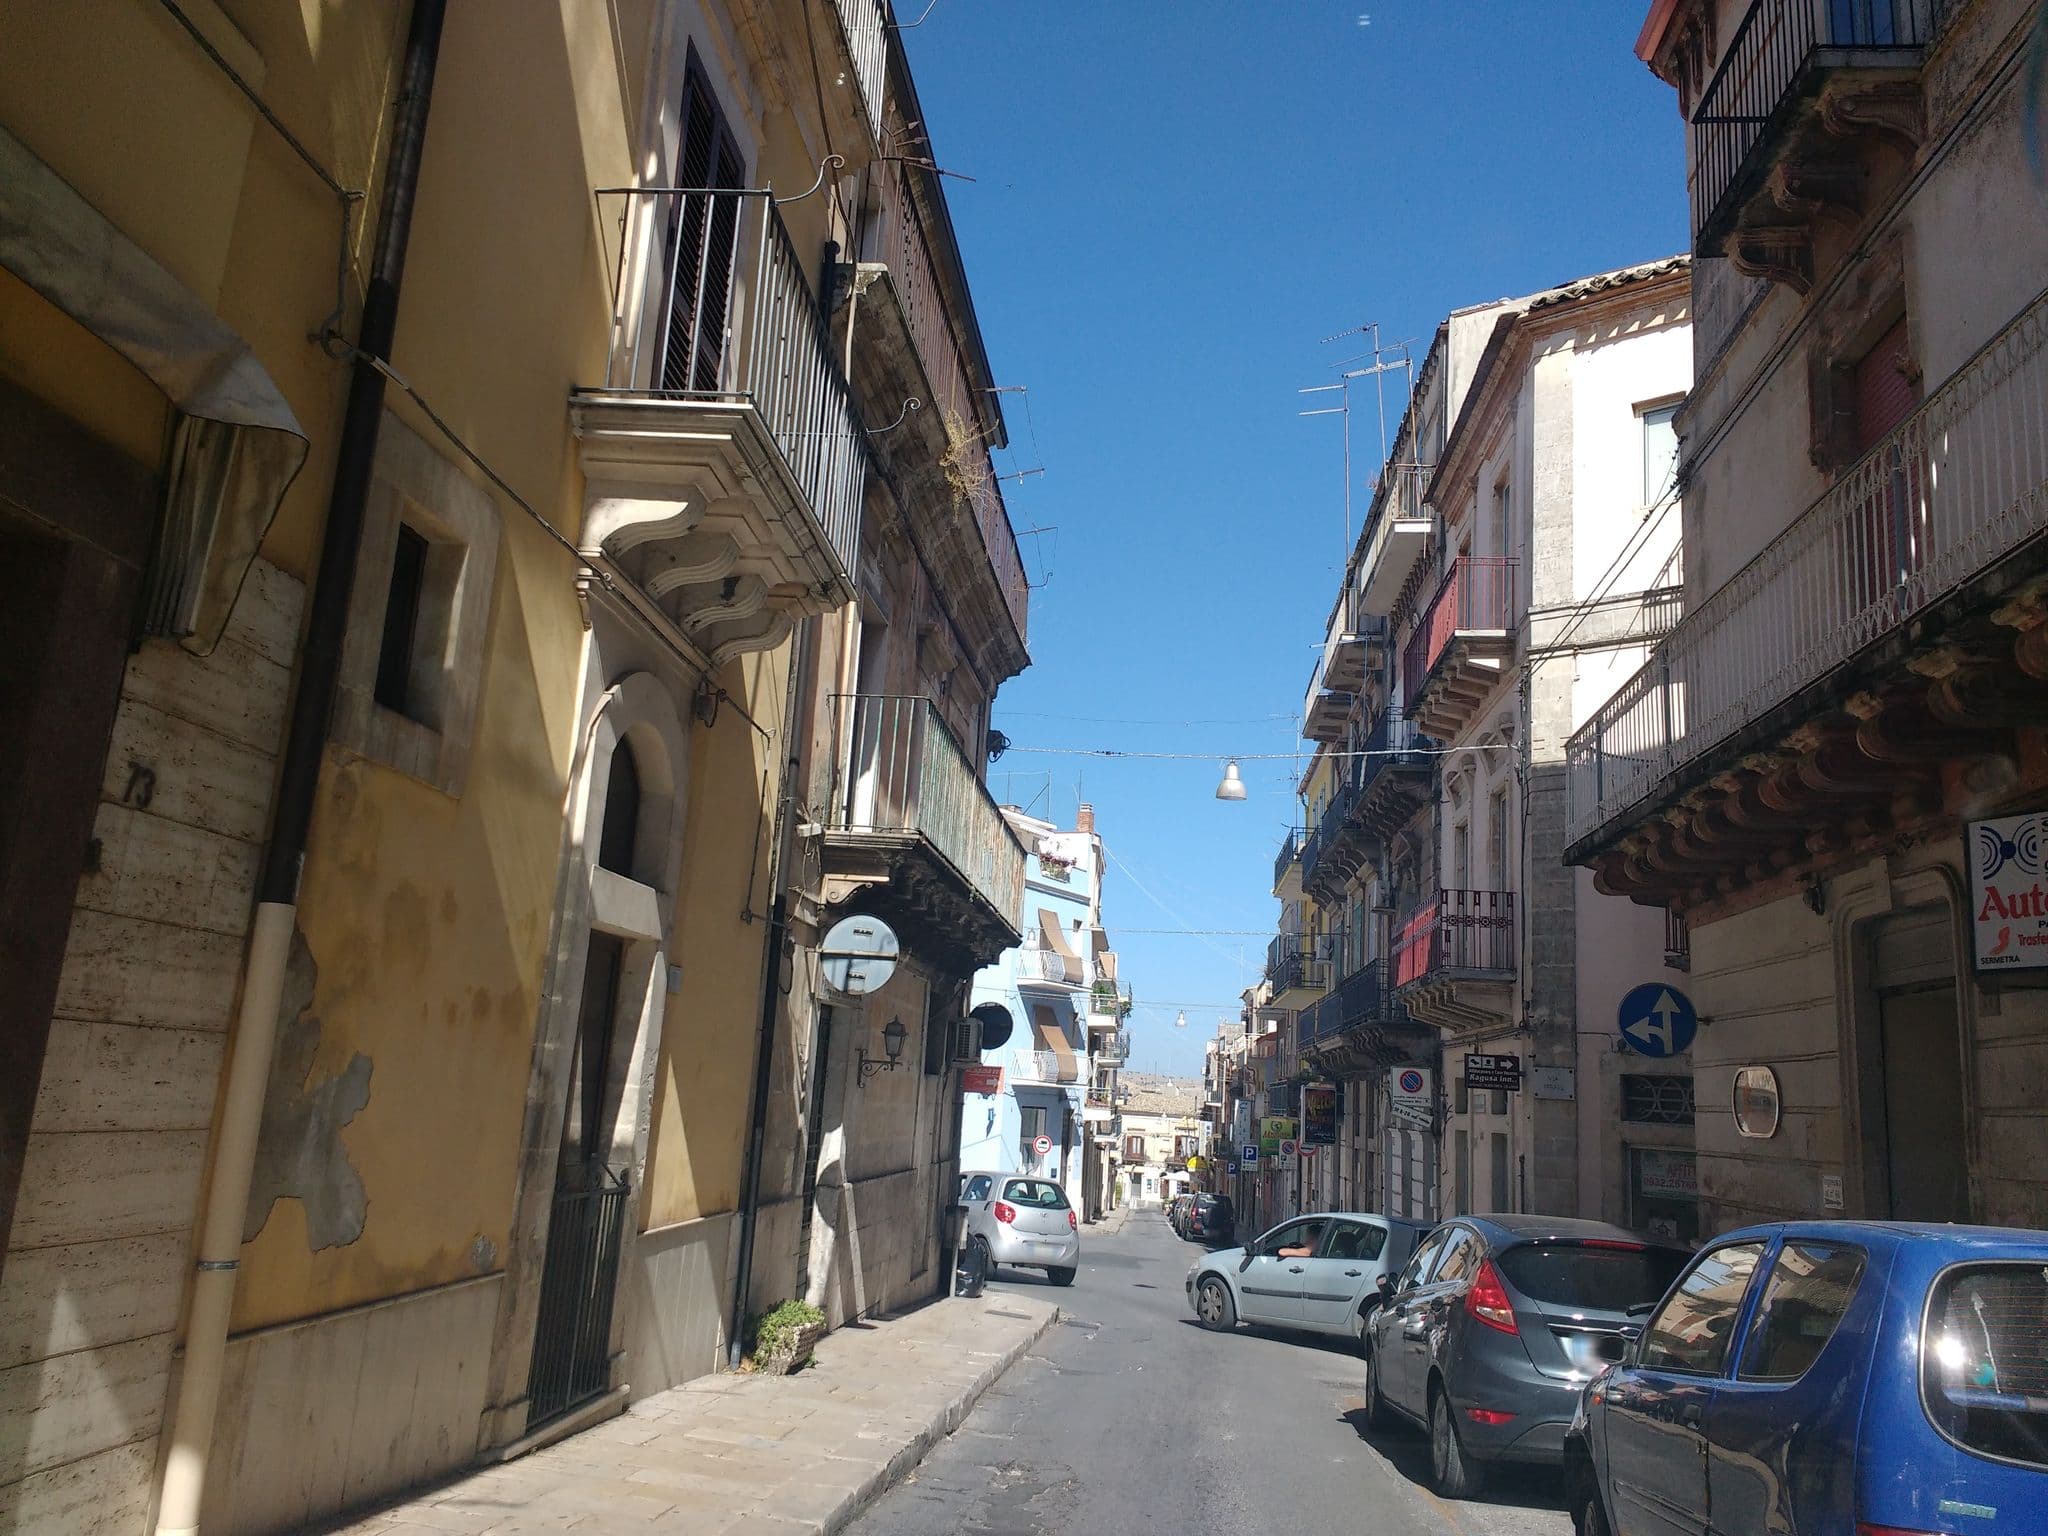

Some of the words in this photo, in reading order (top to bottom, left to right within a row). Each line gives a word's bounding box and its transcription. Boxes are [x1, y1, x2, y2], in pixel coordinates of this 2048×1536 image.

[1980, 955, 2020, 965] SERMETRA
[1470, 1073, 1498, 1083] Ragusa
[1245, 1147, 1254, 1159] P
